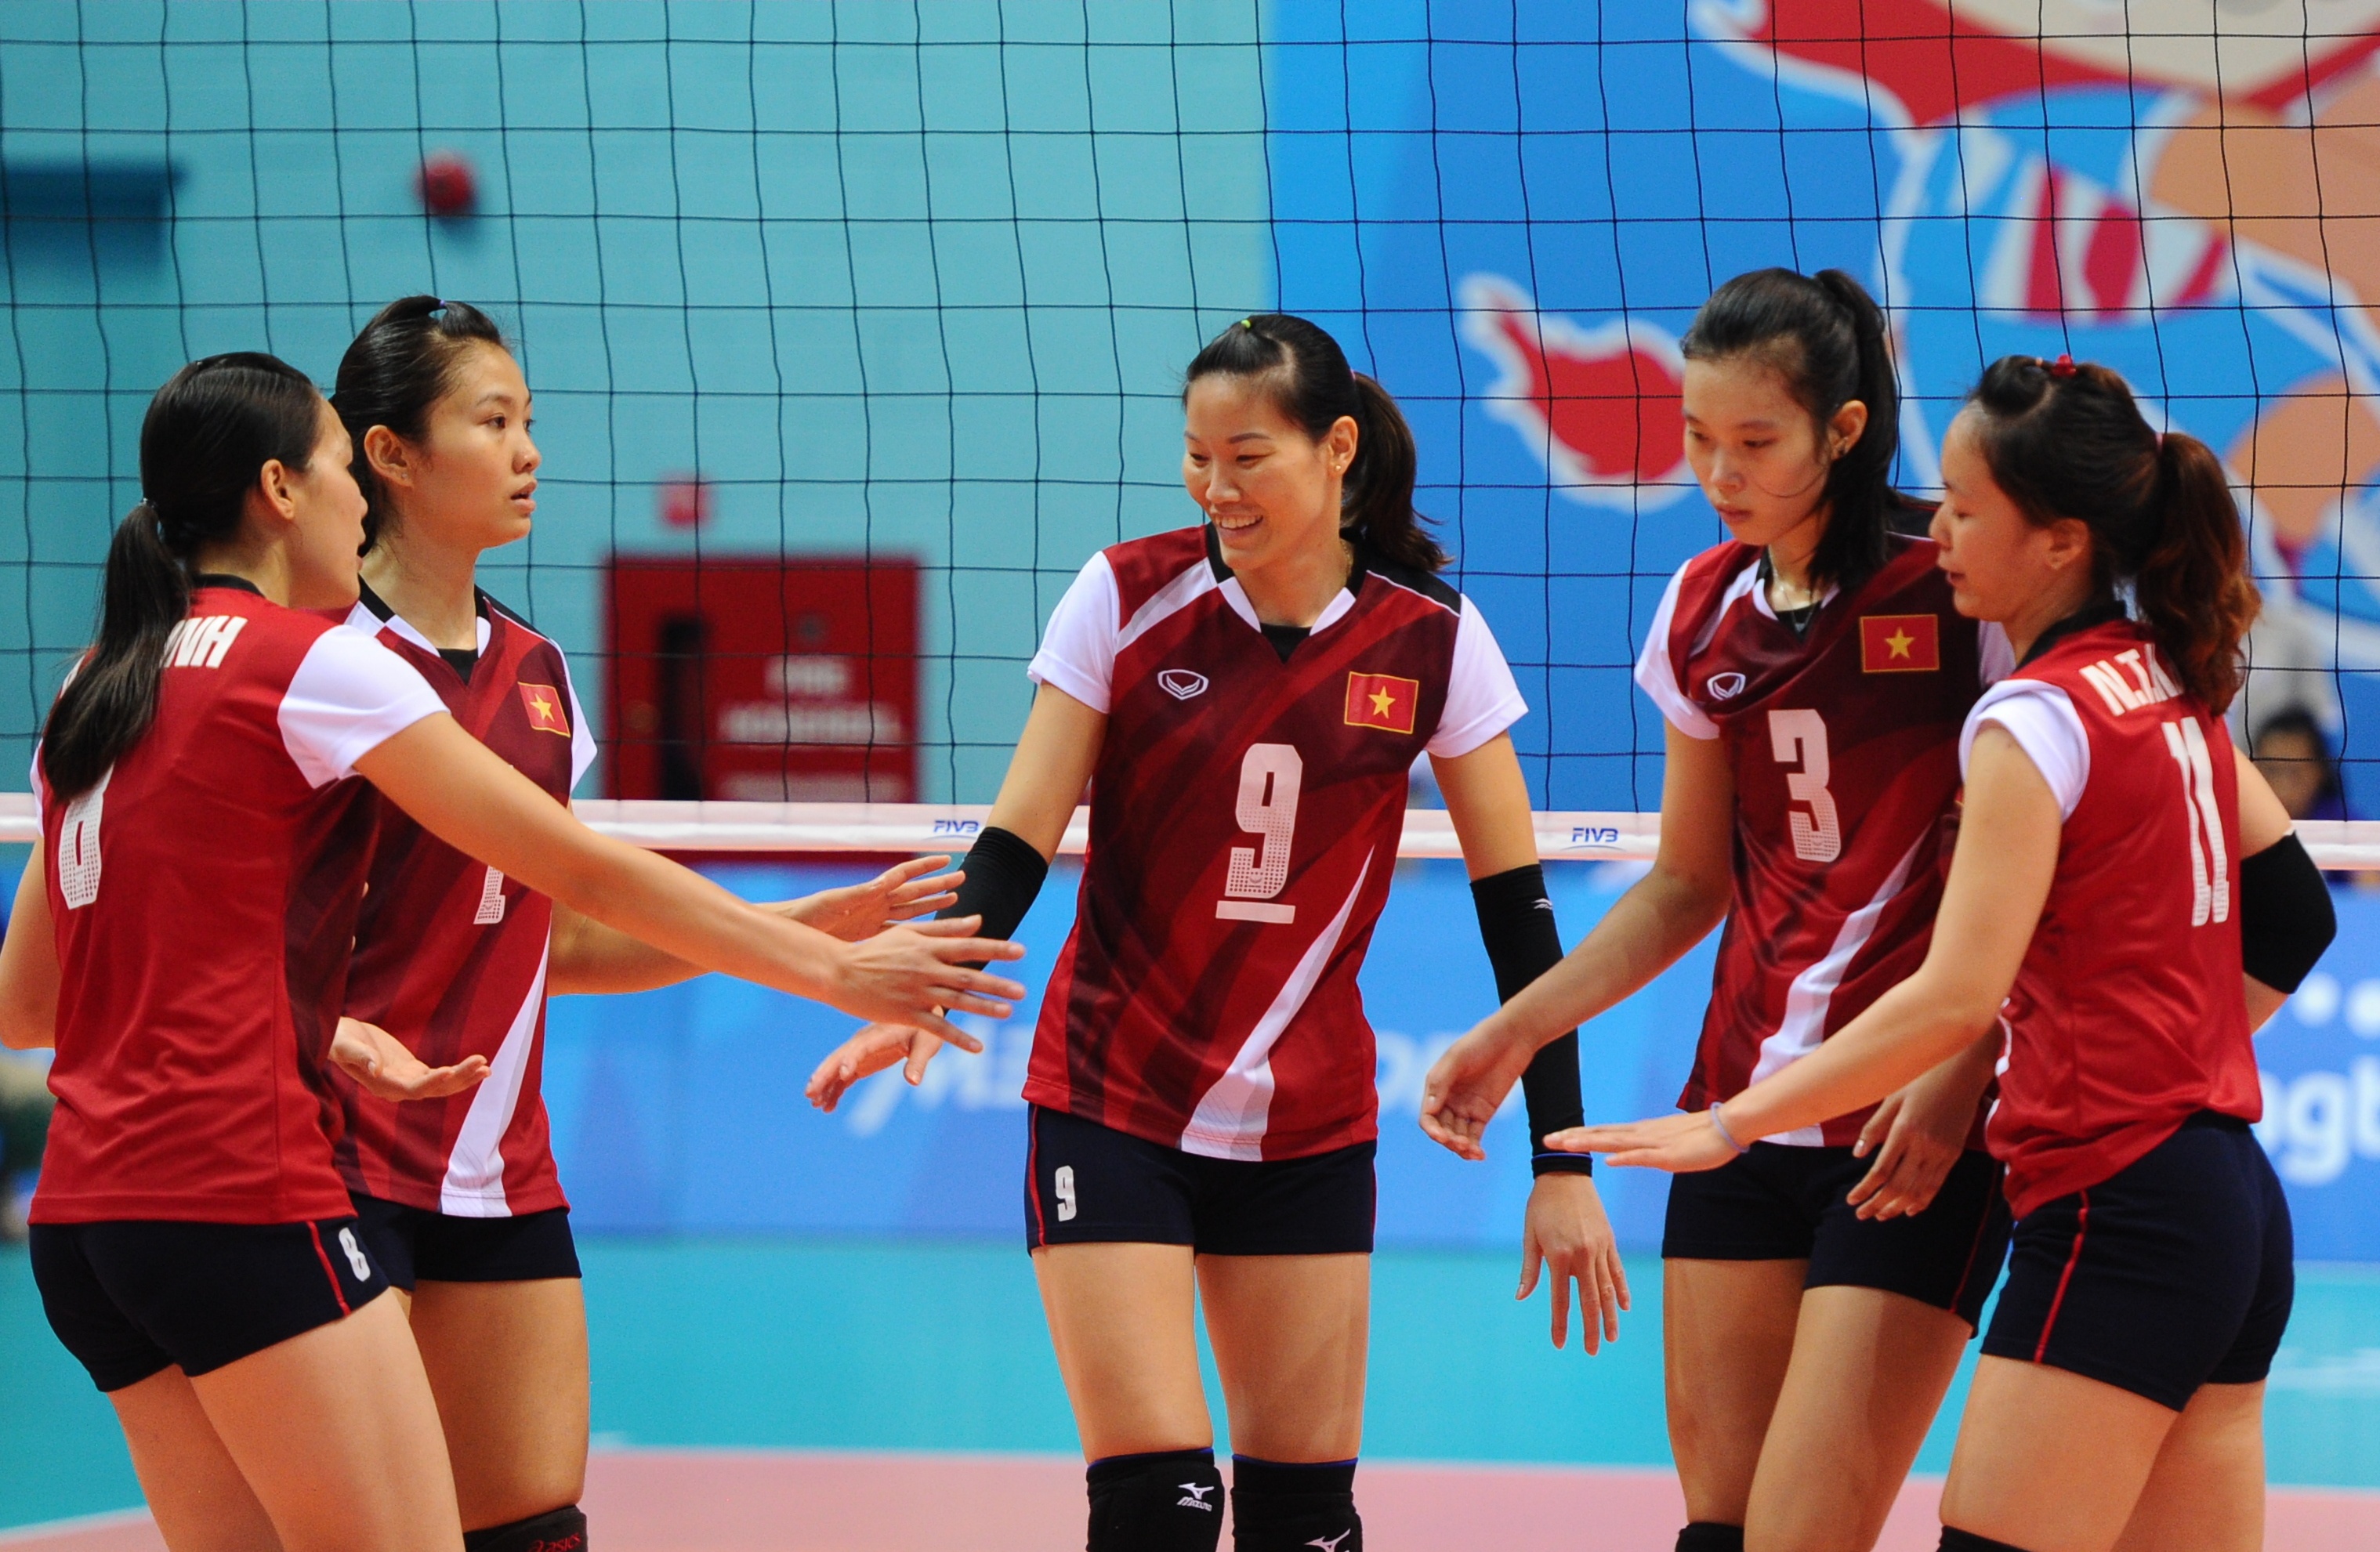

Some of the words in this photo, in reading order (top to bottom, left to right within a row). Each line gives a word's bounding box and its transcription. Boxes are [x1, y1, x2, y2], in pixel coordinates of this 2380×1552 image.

[1768, 709, 1842, 863] 3
[933, 820, 979, 832] FIVB
[1224, 743, 1303, 899] 9
[1571, 827, 1618, 842] FIVB
[2161, 716, 2230, 926] 11
[1055, 1165, 1078, 1221] 9
[339, 1227, 371, 1282] 8
